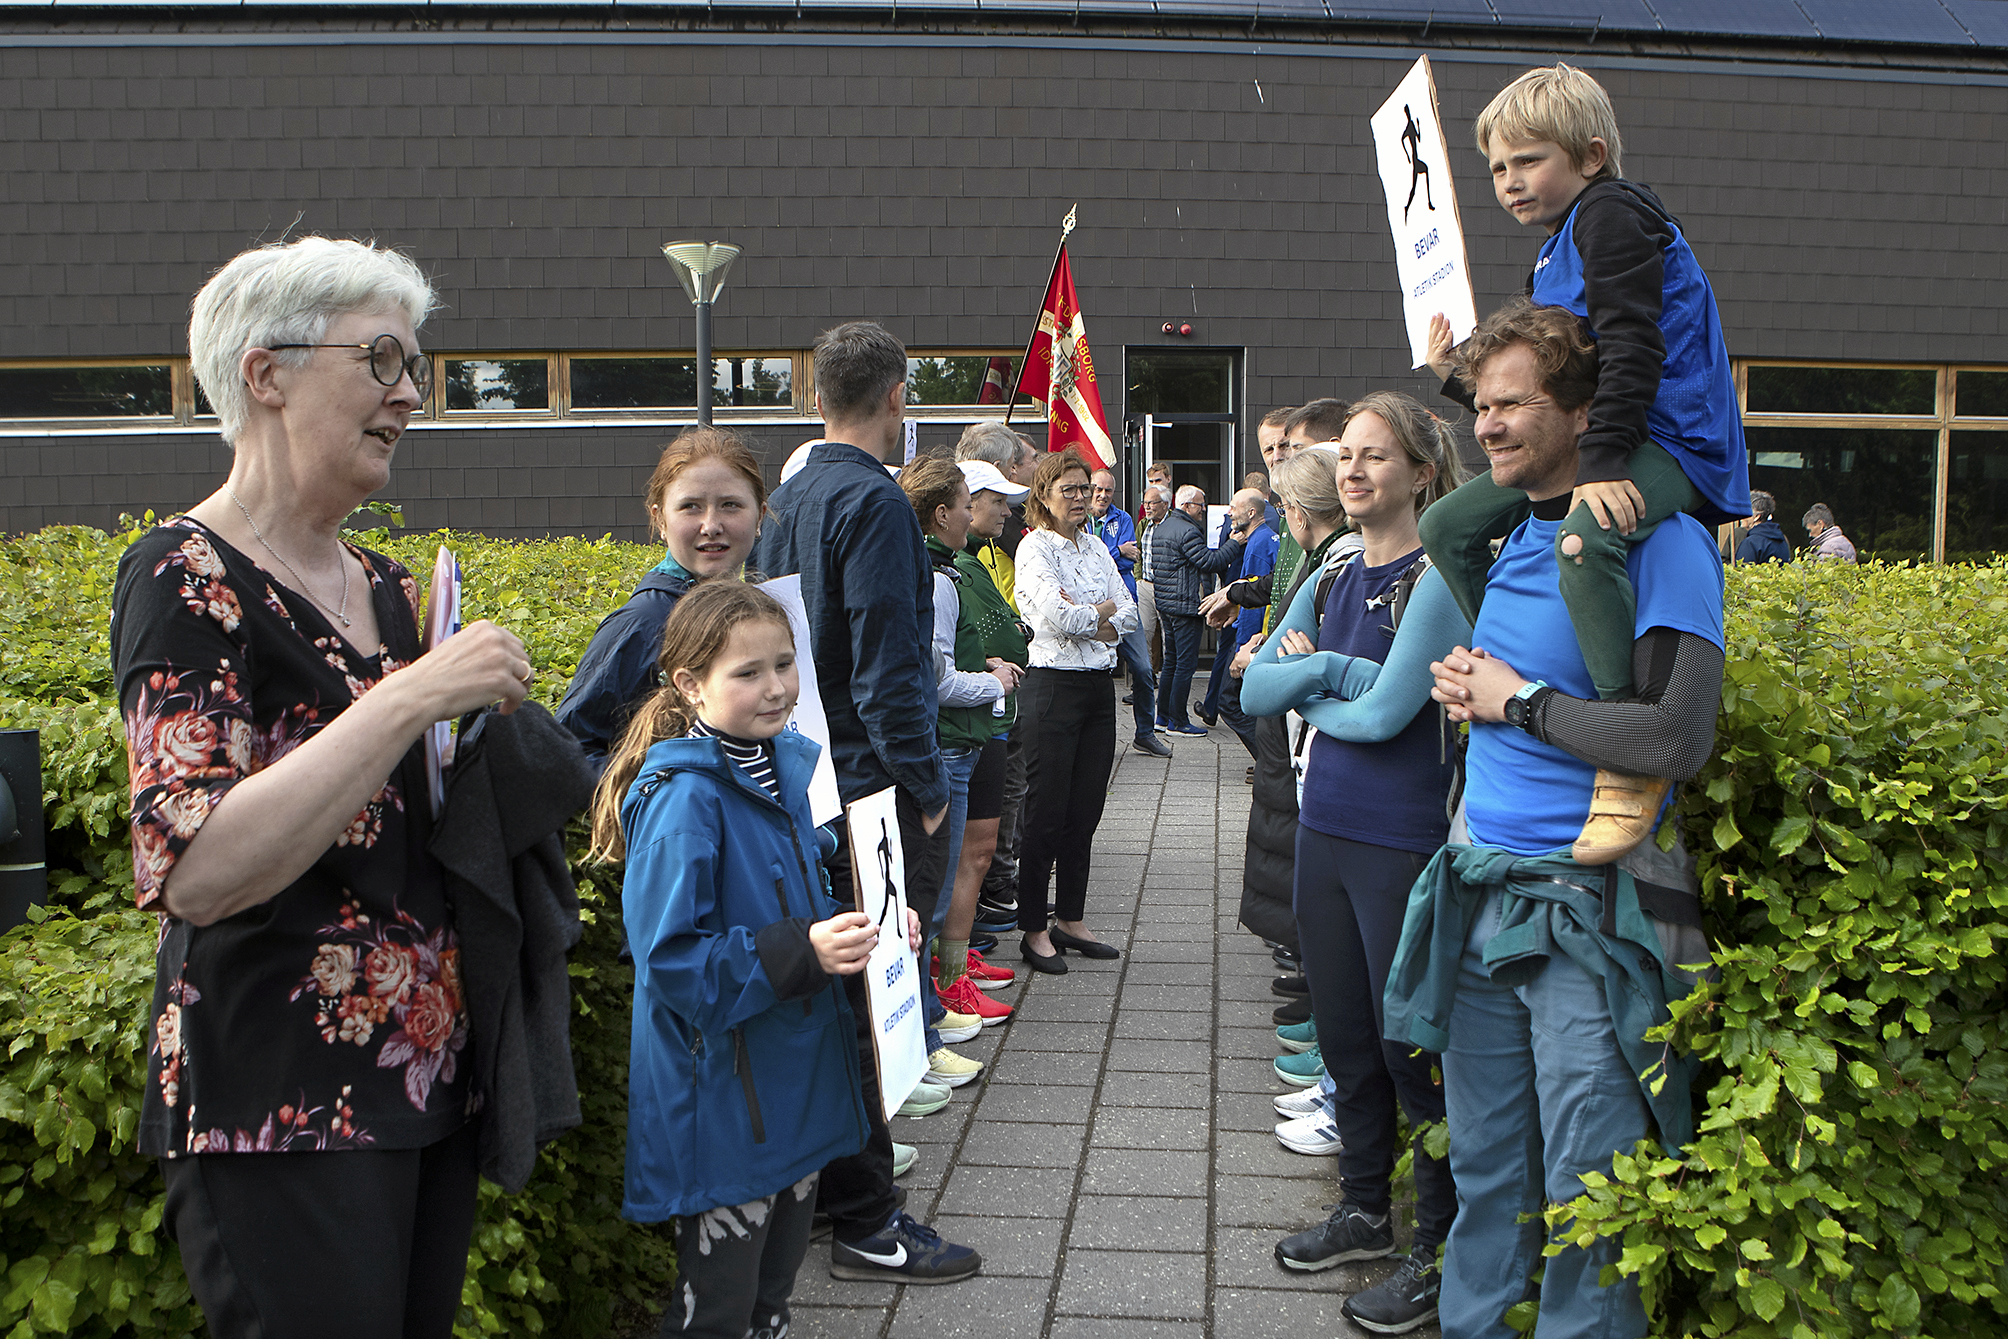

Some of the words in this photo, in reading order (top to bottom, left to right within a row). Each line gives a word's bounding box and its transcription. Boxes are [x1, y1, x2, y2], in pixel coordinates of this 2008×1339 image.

[1414, 227, 1440, 260] BEVAR
[1413, 276, 1433, 300] ATLETIK
[1432, 259, 1454, 286] STADION
[885, 956, 905, 989] BEVAR
[883, 1009, 900, 1036] ATLETIK
[899, 993, 916, 1020] STADION
